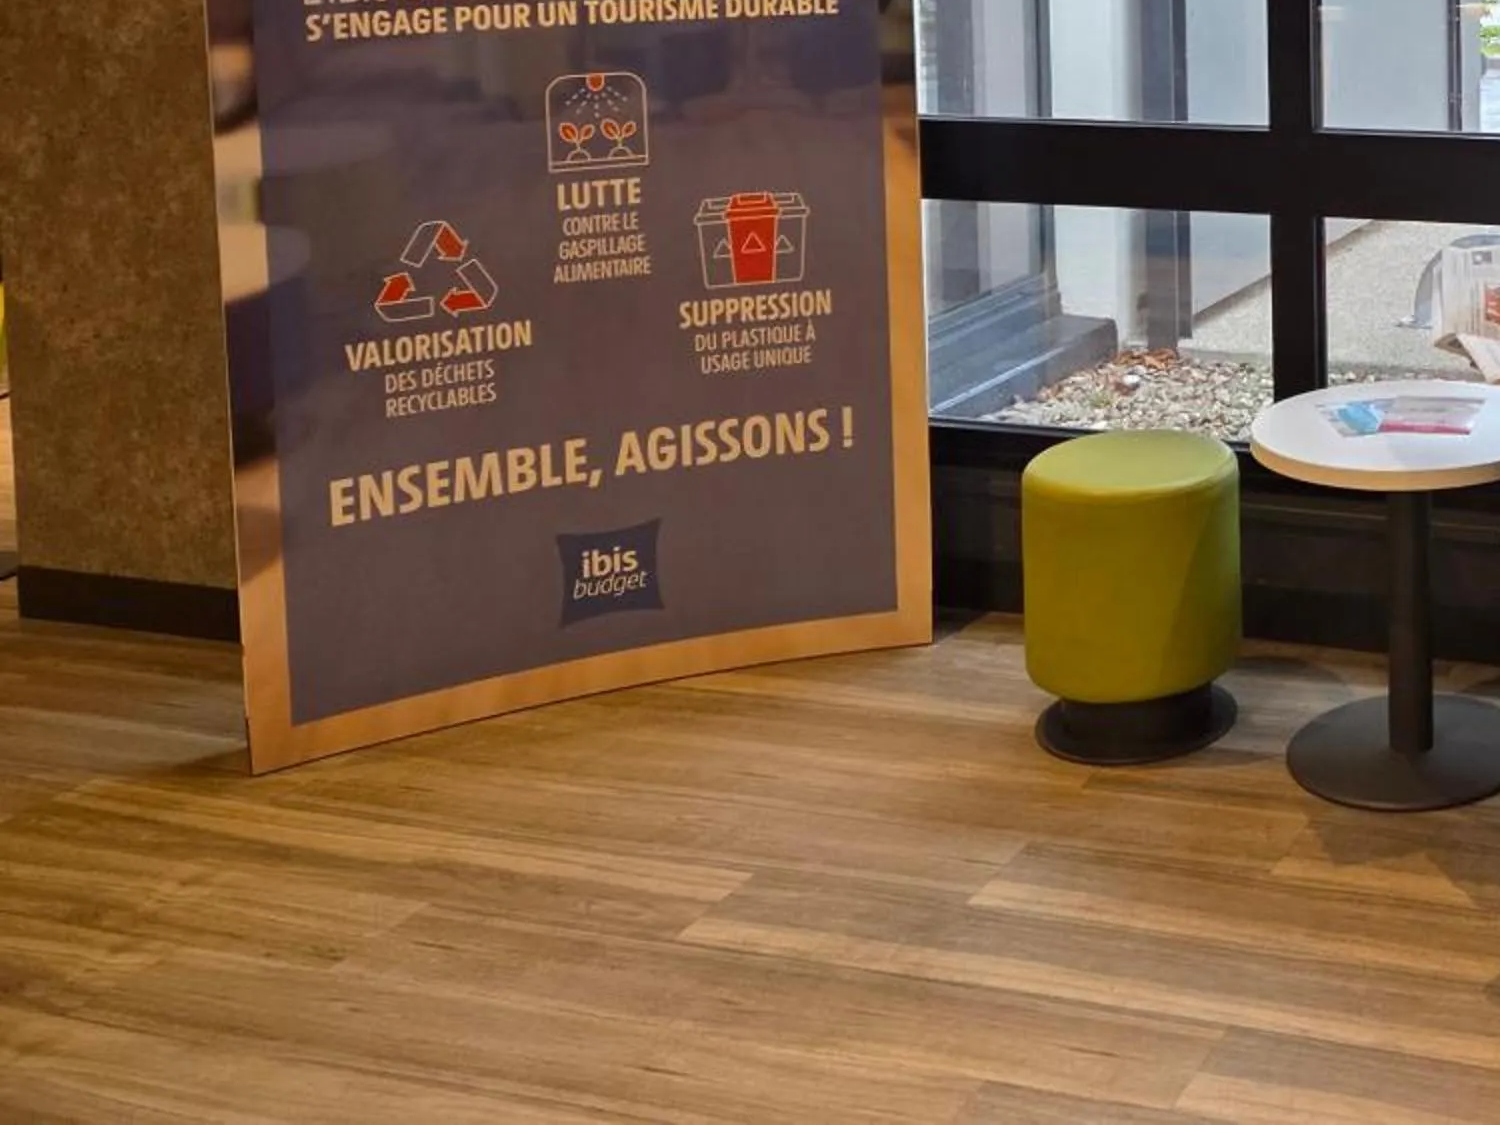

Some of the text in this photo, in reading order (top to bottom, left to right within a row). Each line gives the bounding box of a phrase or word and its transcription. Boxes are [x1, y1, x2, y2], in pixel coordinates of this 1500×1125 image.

[454, 3, 531, 33] POUR
[538, 2, 577, 28] UN
[557, 177, 642, 212] LUTTE
[563, 213, 639, 236] CONTRE LE
[559, 235, 646, 260] GASPILLAGE
[553, 257, 652, 284] ALIMENTAIRE
[678, 289, 834, 330] SUPPRESSION
[344, 320, 533, 372] VALORISATION
[694, 322, 817, 352] DU PLASTIQUE À
[384, 359, 495, 395] DES DÉCHETS
[700, 347, 813, 375] USAGE UNIQUE
[386, 383, 498, 418] RECYCLABLES
[328, 405, 855, 527] ENSEMBLE, AGISSONS !
[582, 546, 638, 579] ibis
[572, 571, 648, 600] budget
